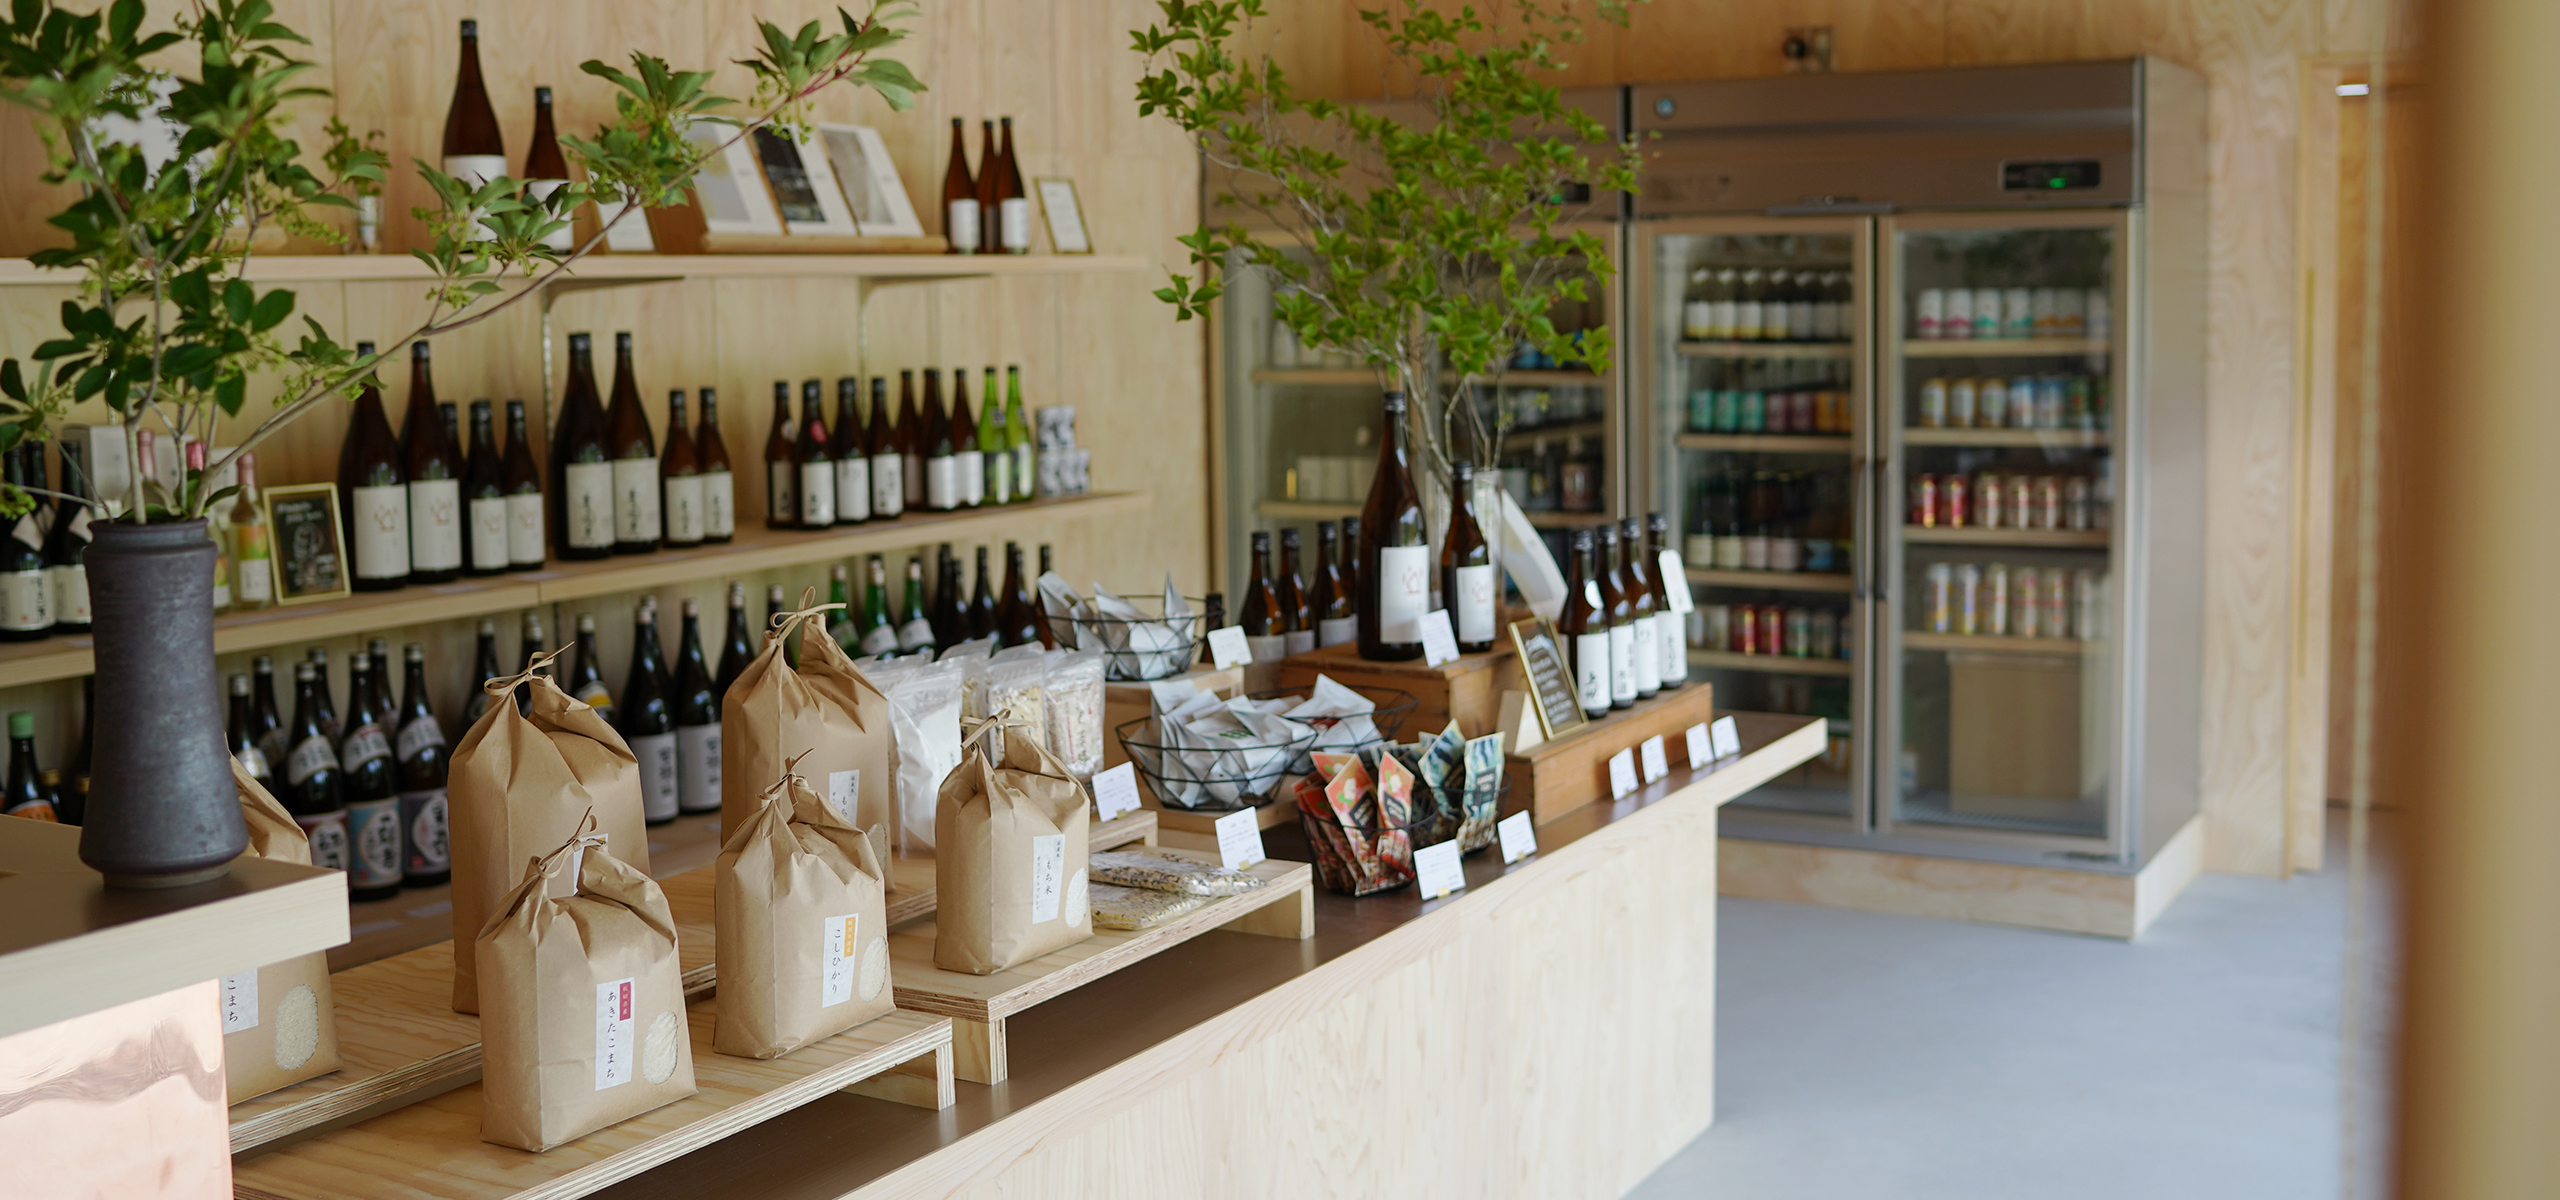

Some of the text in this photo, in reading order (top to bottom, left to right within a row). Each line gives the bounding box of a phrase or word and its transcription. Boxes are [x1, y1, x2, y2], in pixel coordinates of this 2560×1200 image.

[1044, 860, 1053, 895] もち米
[831, 929, 841, 995] こしひかり
[228, 979, 239, 1022] こまち
[607, 991, 617, 1079] あきたこまち
